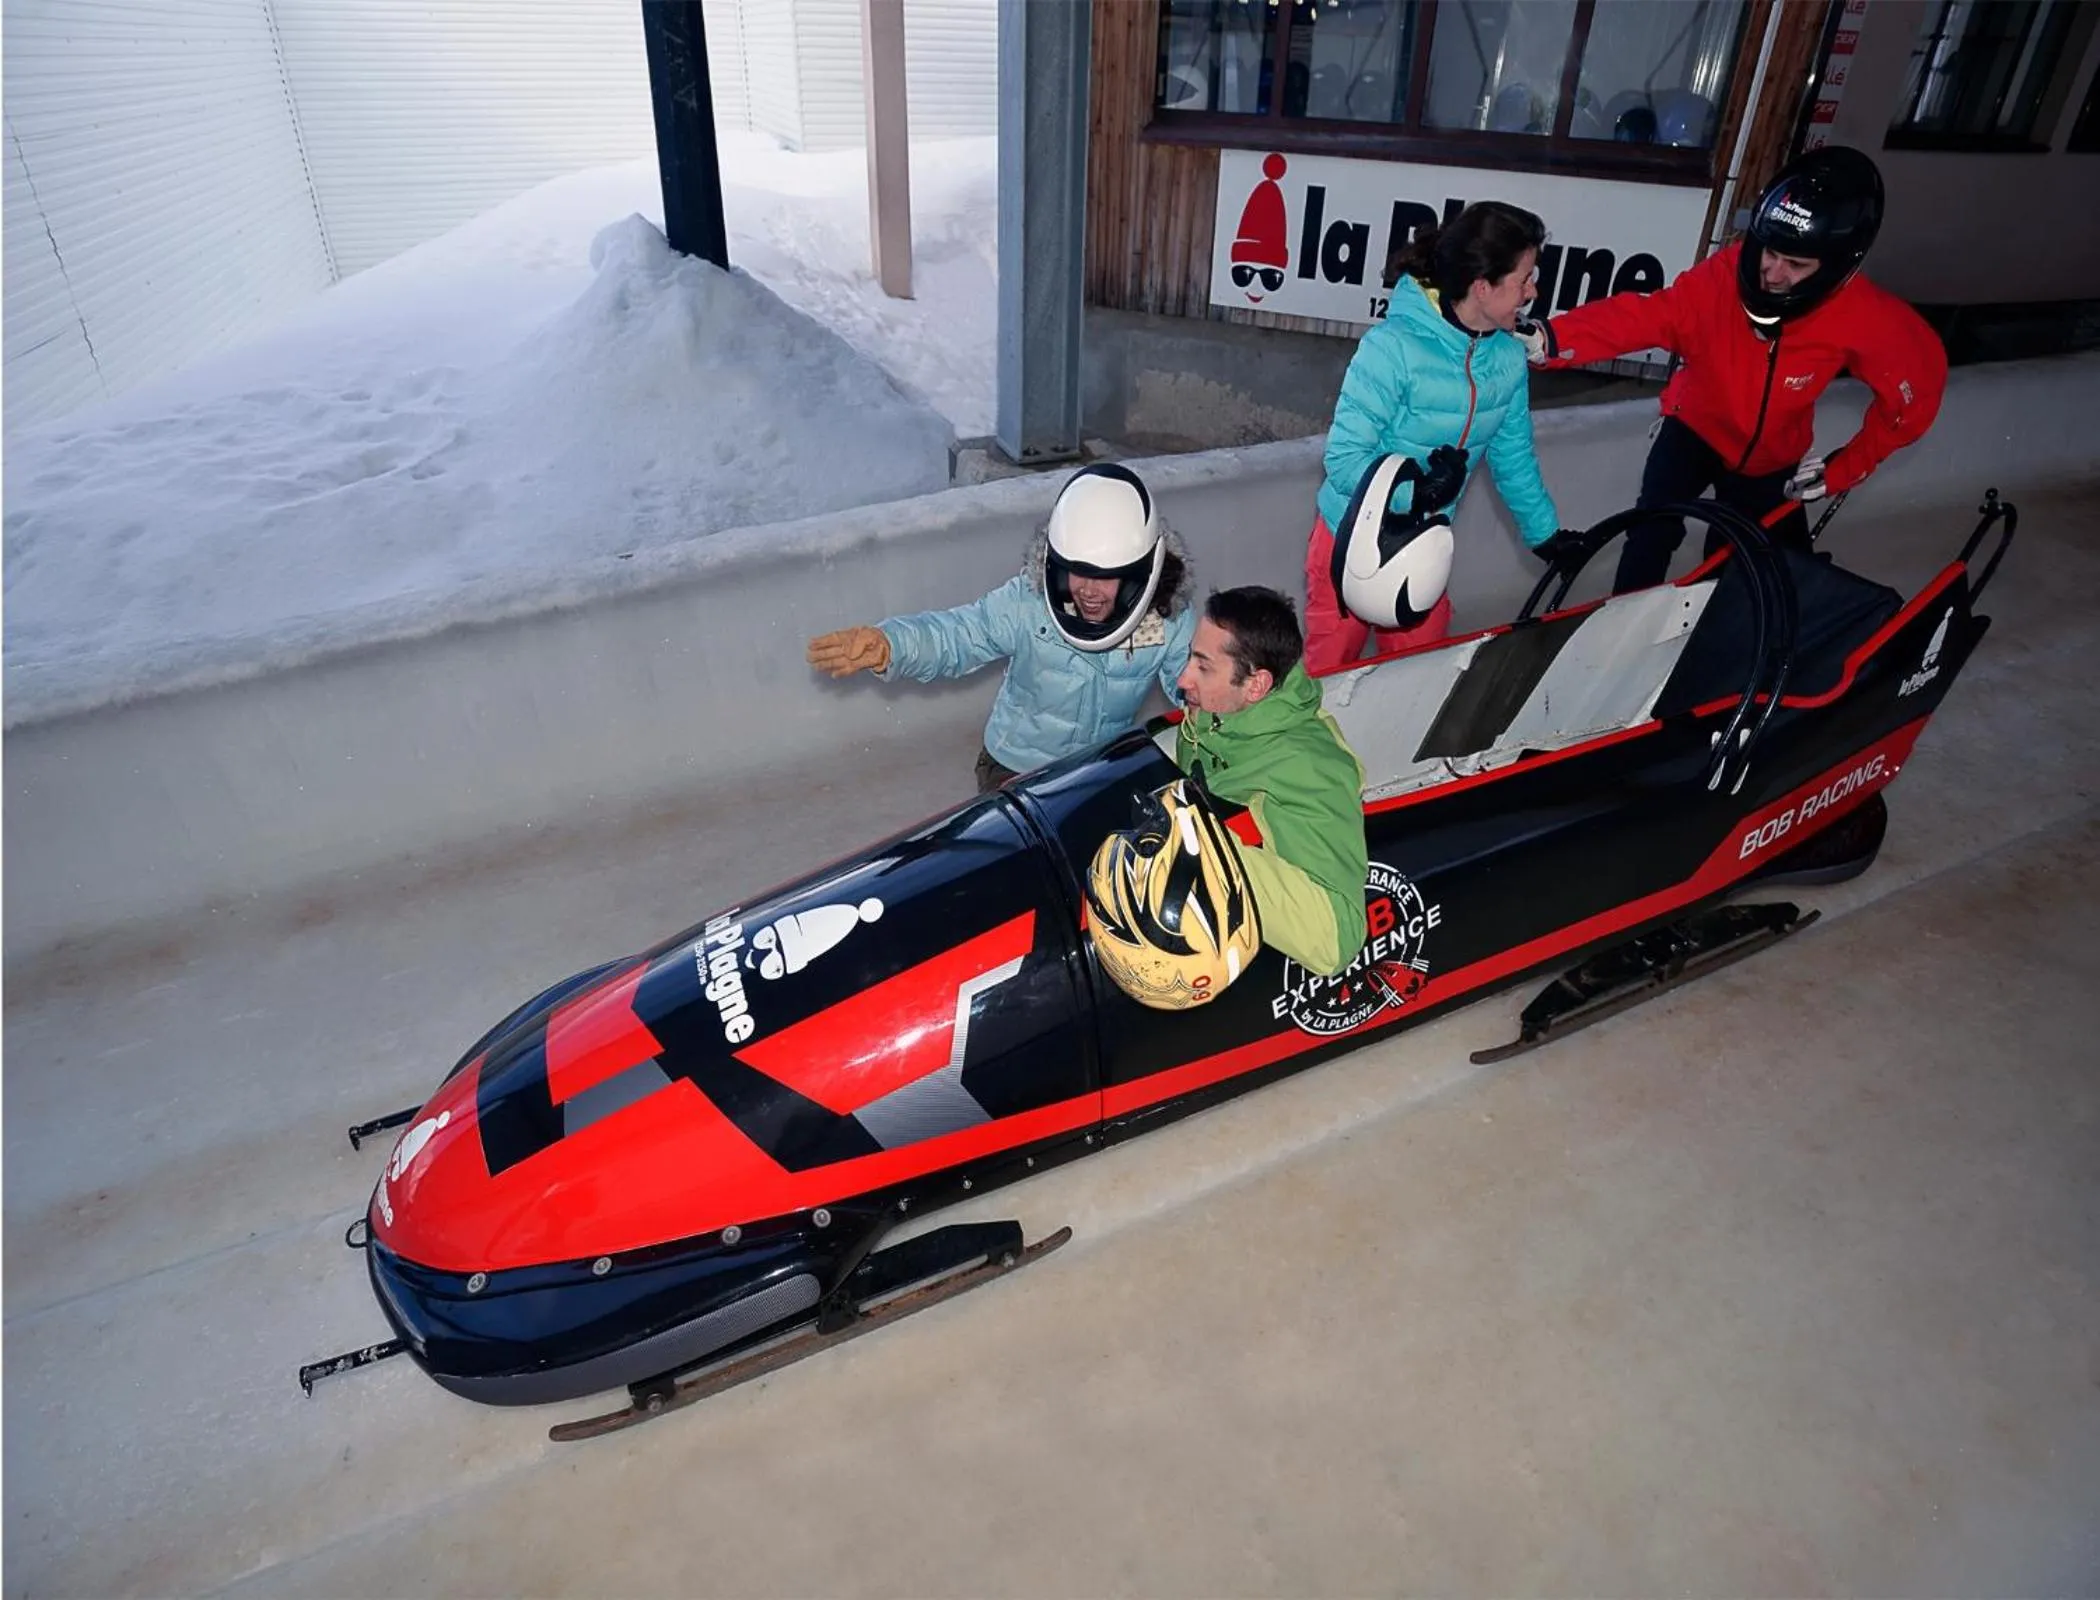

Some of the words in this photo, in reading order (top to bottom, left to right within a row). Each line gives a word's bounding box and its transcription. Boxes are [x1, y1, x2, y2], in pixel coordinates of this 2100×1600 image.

[1770, 206, 1814, 232] SHARK
[1297, 185, 1370, 286] la
[1383, 199, 1664, 317] Pne
[1370, 298, 1389, 319] 12
[1739, 808, 1795, 860] BOB
[1797, 754, 1886, 826] RACING
[1367, 870, 1414, 905] RANCE
[705, 923, 756, 1043] Plagne
[1301, 1008, 1315, 1025] by
[1313, 1016, 1326, 1030] LA
